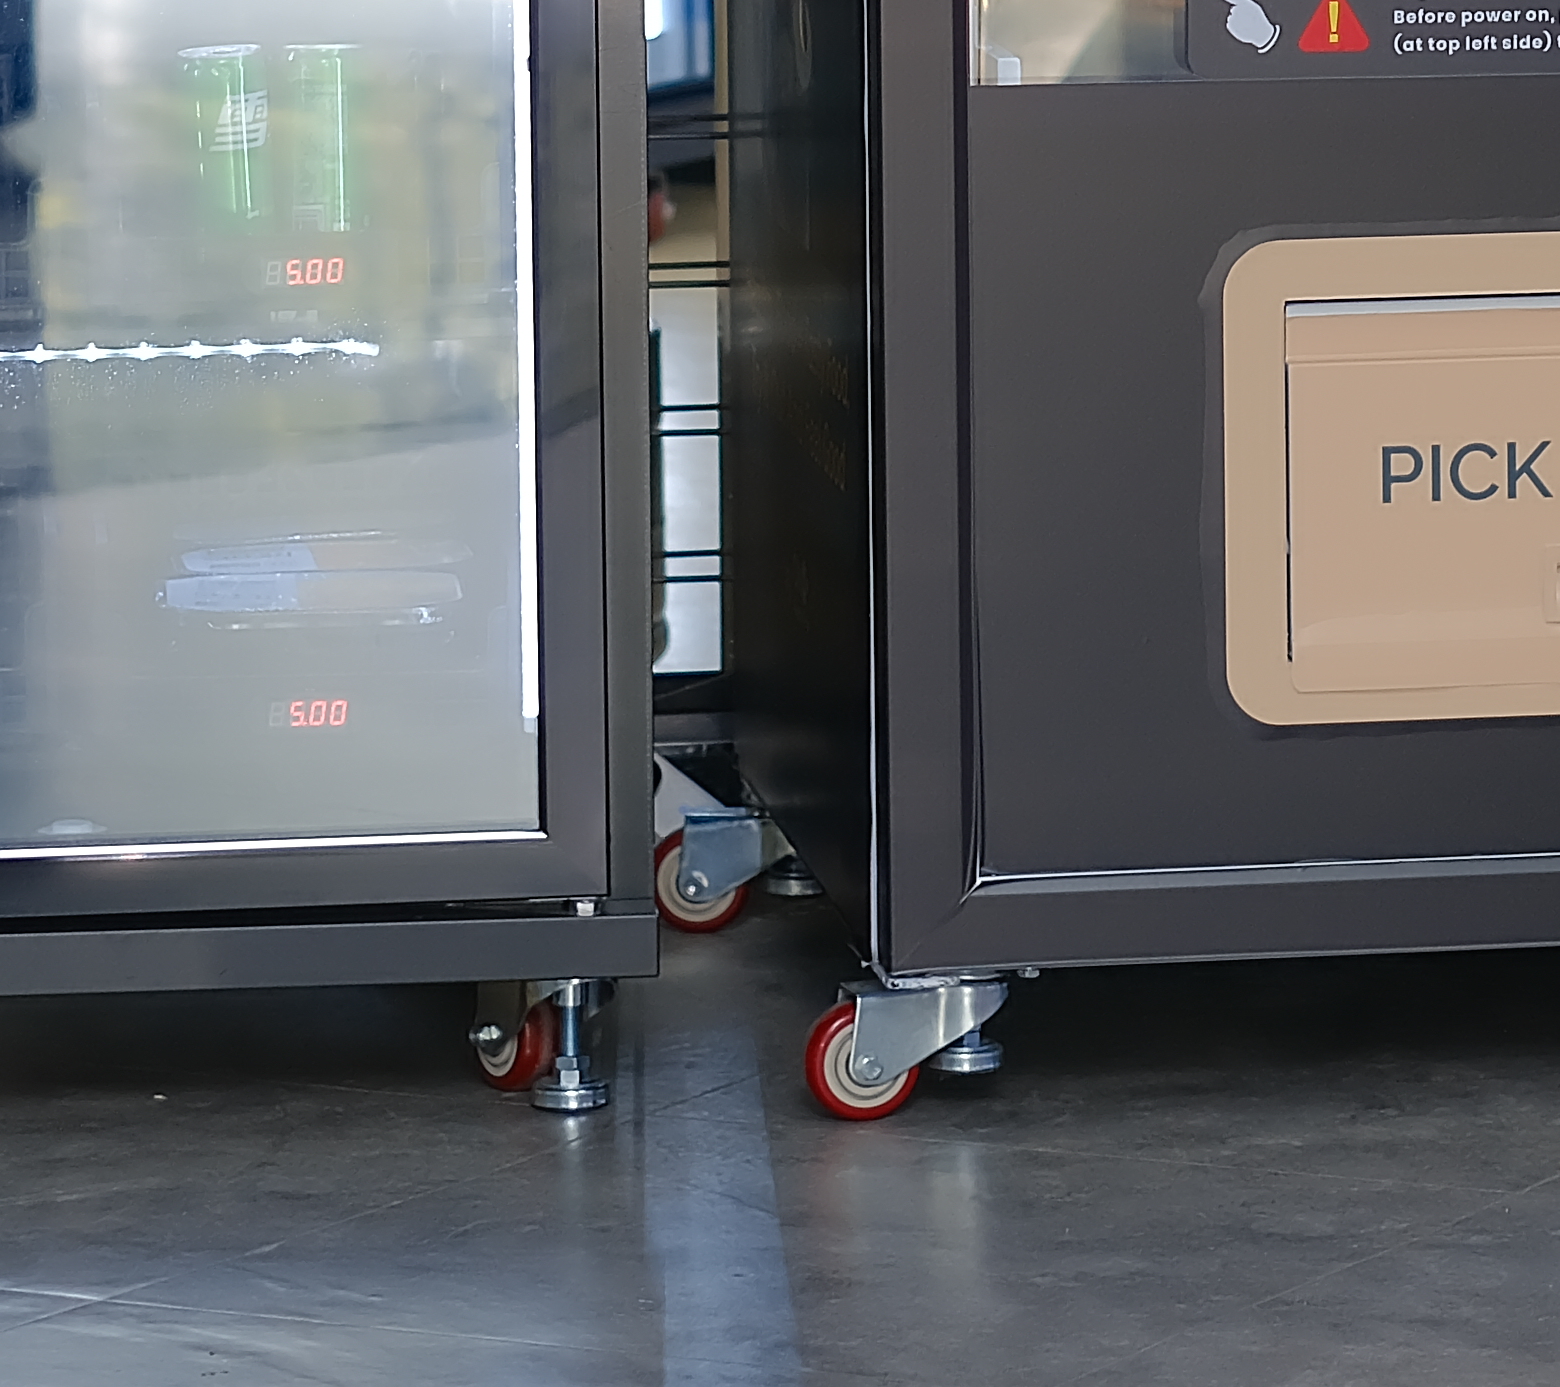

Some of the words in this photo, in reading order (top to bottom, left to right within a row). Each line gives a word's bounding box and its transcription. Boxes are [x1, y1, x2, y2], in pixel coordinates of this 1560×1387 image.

[1393, 8, 1457, 24] Before
[1461, 10, 1522, 28] power
[1525, 9, 1555, 24] on,
[286, 258, 344, 284] 5.00
[1381, 440, 1554, 504] PICK
[290, 700, 347, 726] 5.00
